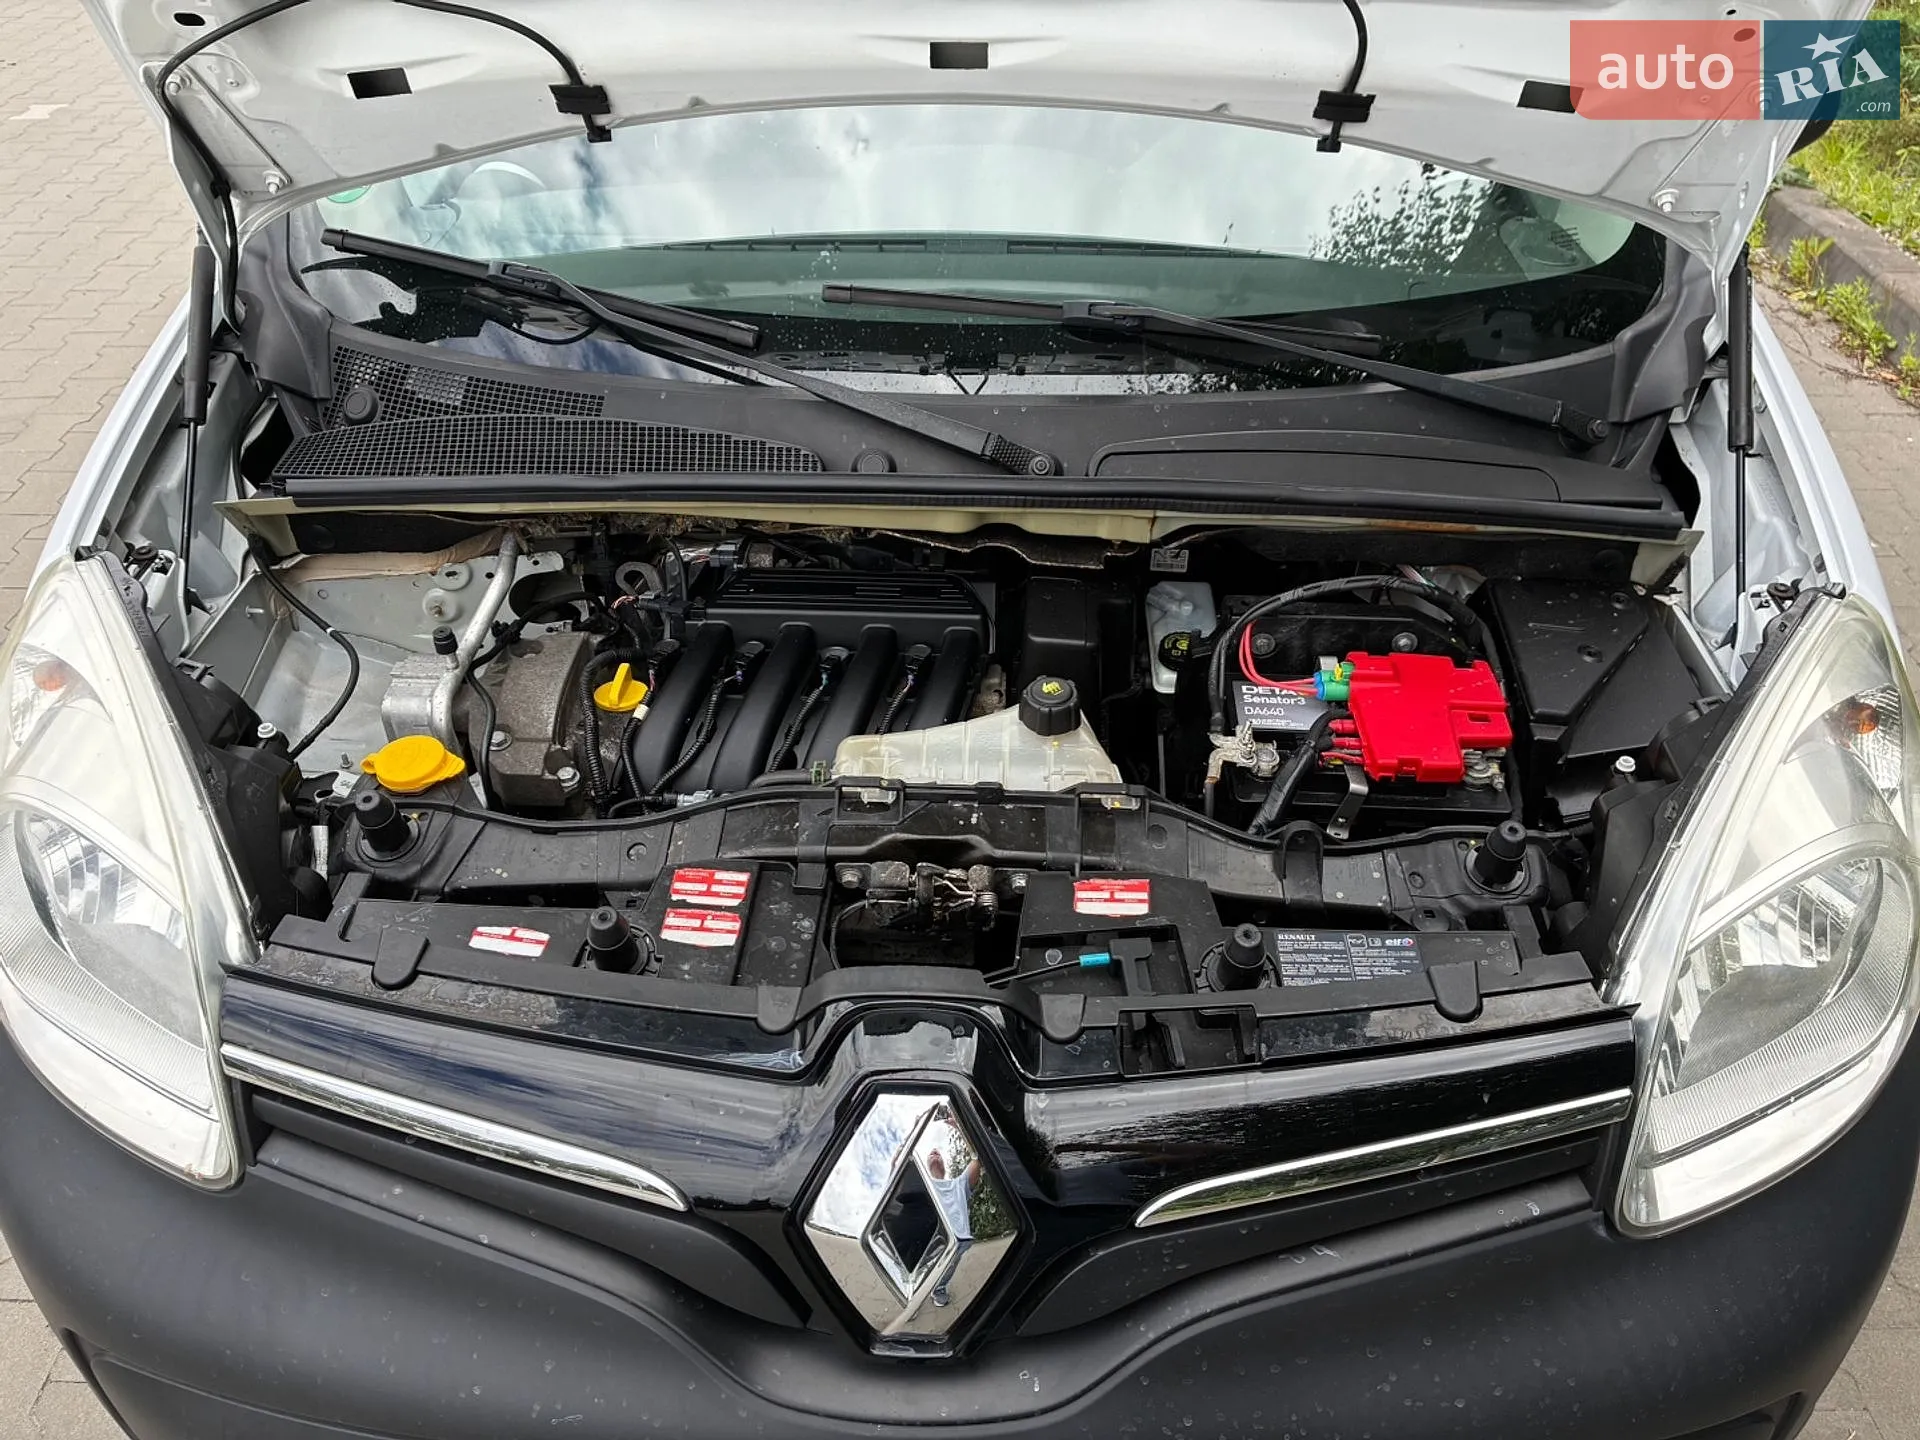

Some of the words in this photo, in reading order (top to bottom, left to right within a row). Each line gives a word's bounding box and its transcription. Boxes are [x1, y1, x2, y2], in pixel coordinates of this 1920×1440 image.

[1244, 706, 1285, 716] DA640
[1277, 933, 1316, 941] RENAULT
[1385, 938, 1402, 946] elf
